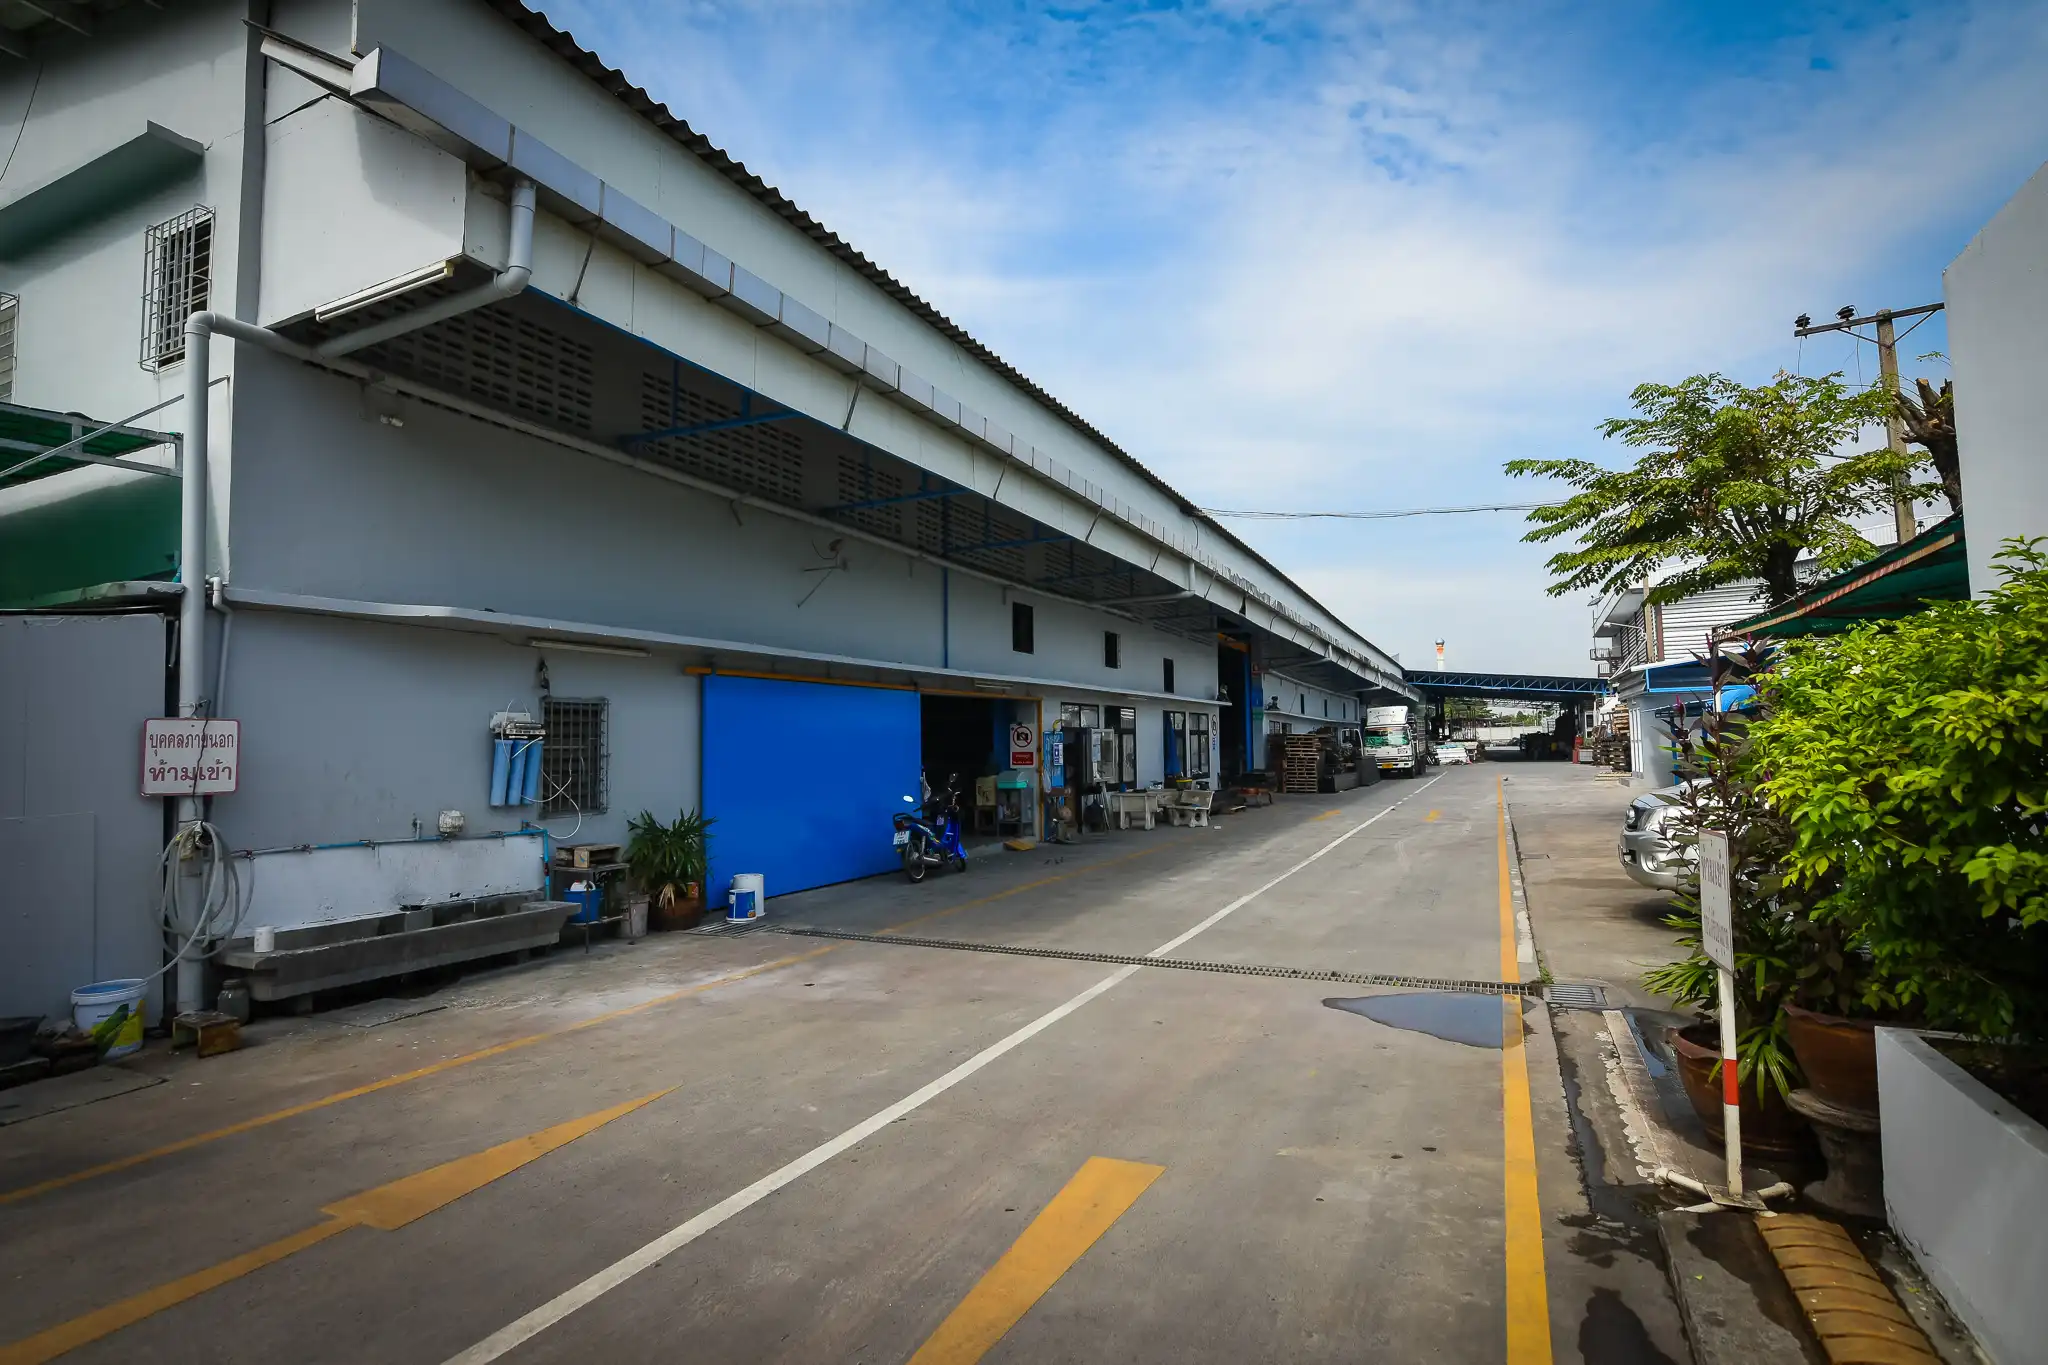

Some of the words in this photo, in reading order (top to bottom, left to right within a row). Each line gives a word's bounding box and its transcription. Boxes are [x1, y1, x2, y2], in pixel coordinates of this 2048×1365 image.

[149, 733, 234, 757] บุคคลภายนอก
[149, 759, 232, 782] ห้ามเข้า
